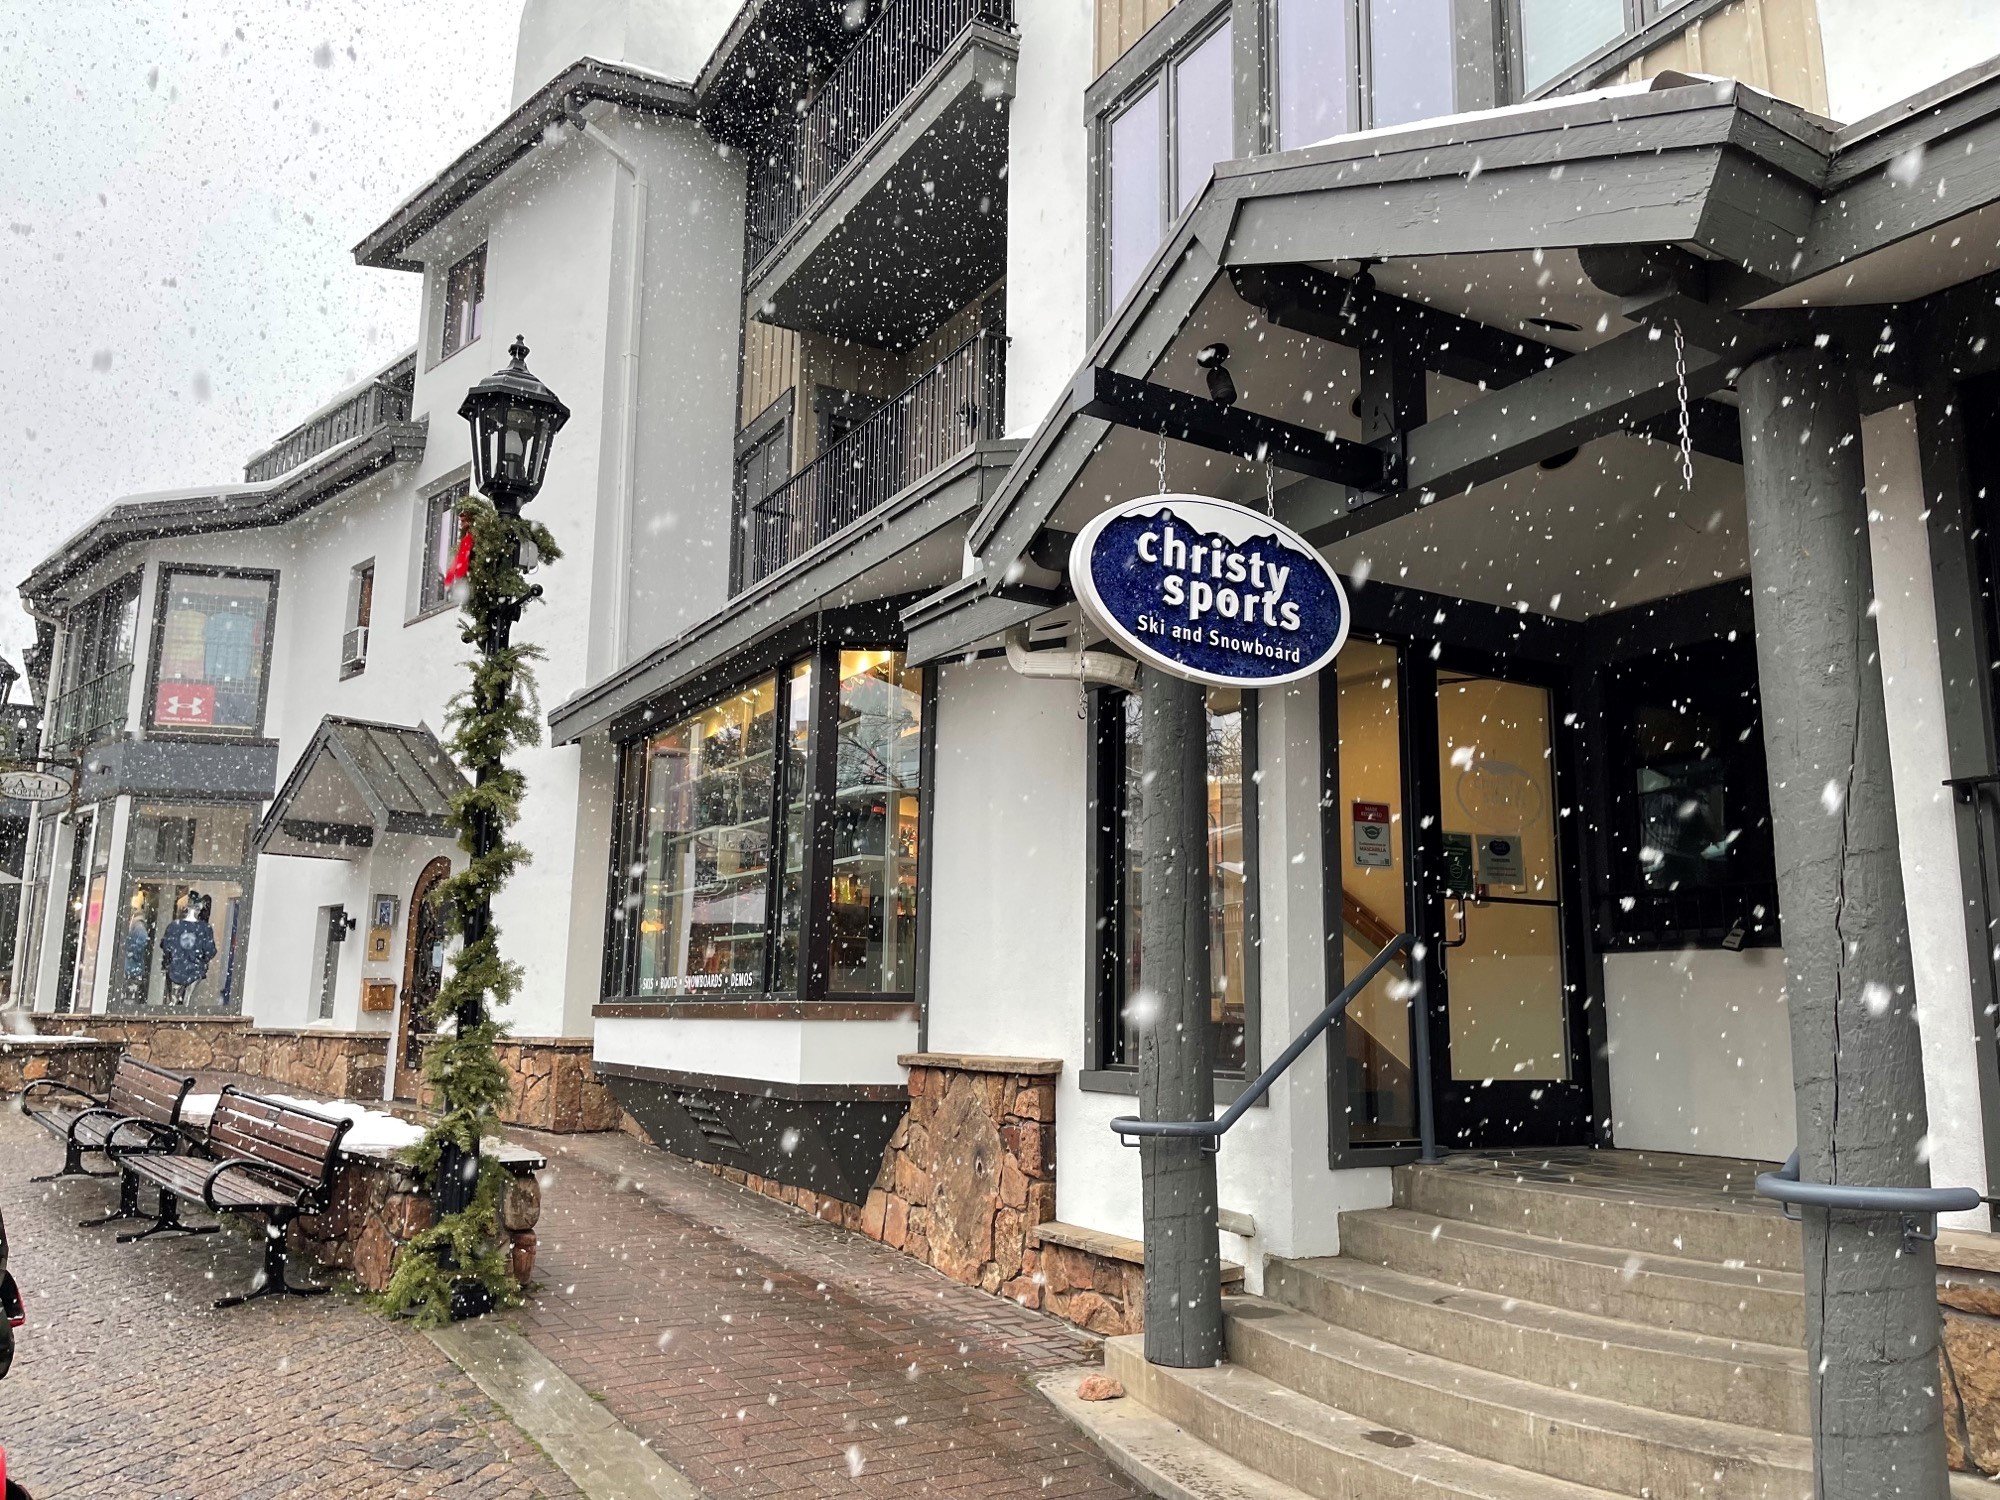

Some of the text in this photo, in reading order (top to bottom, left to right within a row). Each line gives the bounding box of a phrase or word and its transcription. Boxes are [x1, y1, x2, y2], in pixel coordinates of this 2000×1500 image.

[1137, 527, 1290, 603] christy
[1163, 574, 1301, 631] sports
[1137, 614, 1300, 663] Ski and Snowboard
[642, 972, 753, 990] SKIS BOOTS SNOWBOARDS DEMOS
